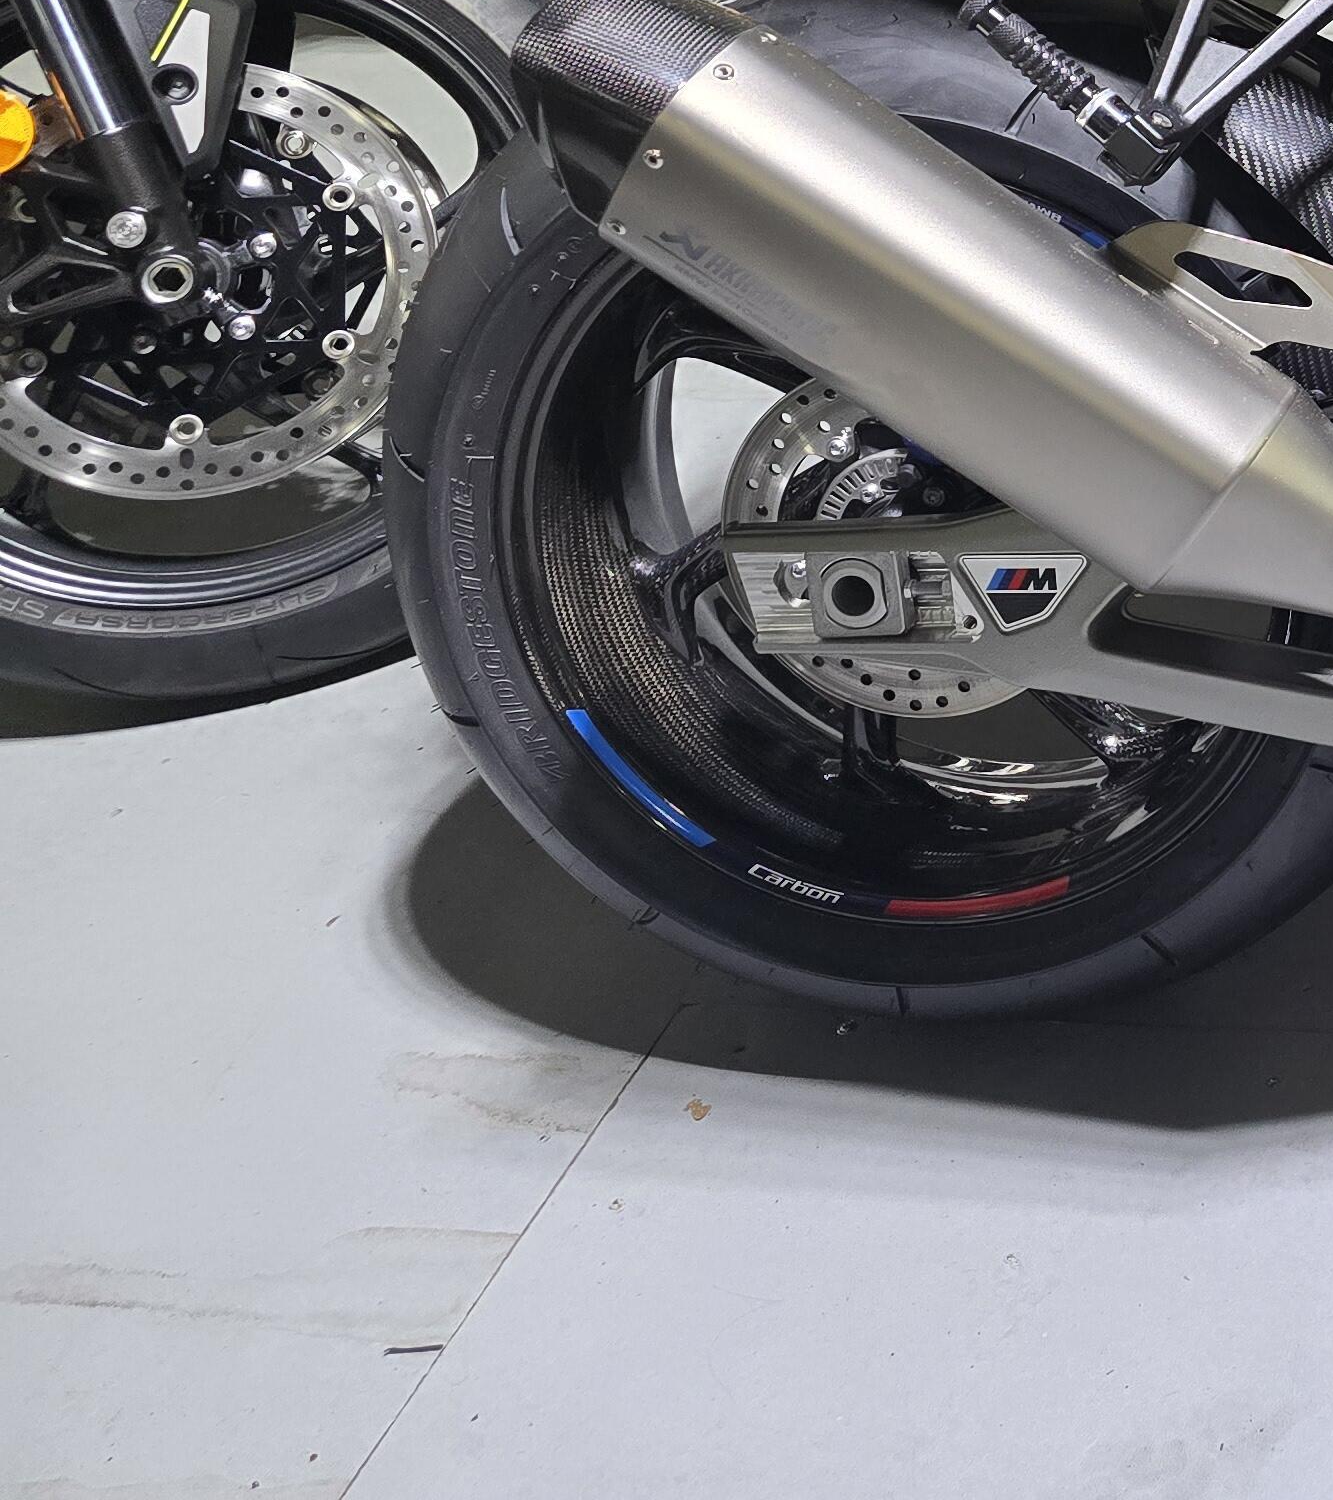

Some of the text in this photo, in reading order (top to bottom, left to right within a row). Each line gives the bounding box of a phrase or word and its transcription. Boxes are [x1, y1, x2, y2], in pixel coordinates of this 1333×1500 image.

[74, 580, 333, 631] SUPERCORSA
[446, 476, 569, 783] BRIDGESTONE
[746, 862, 845, 906] Carbon
